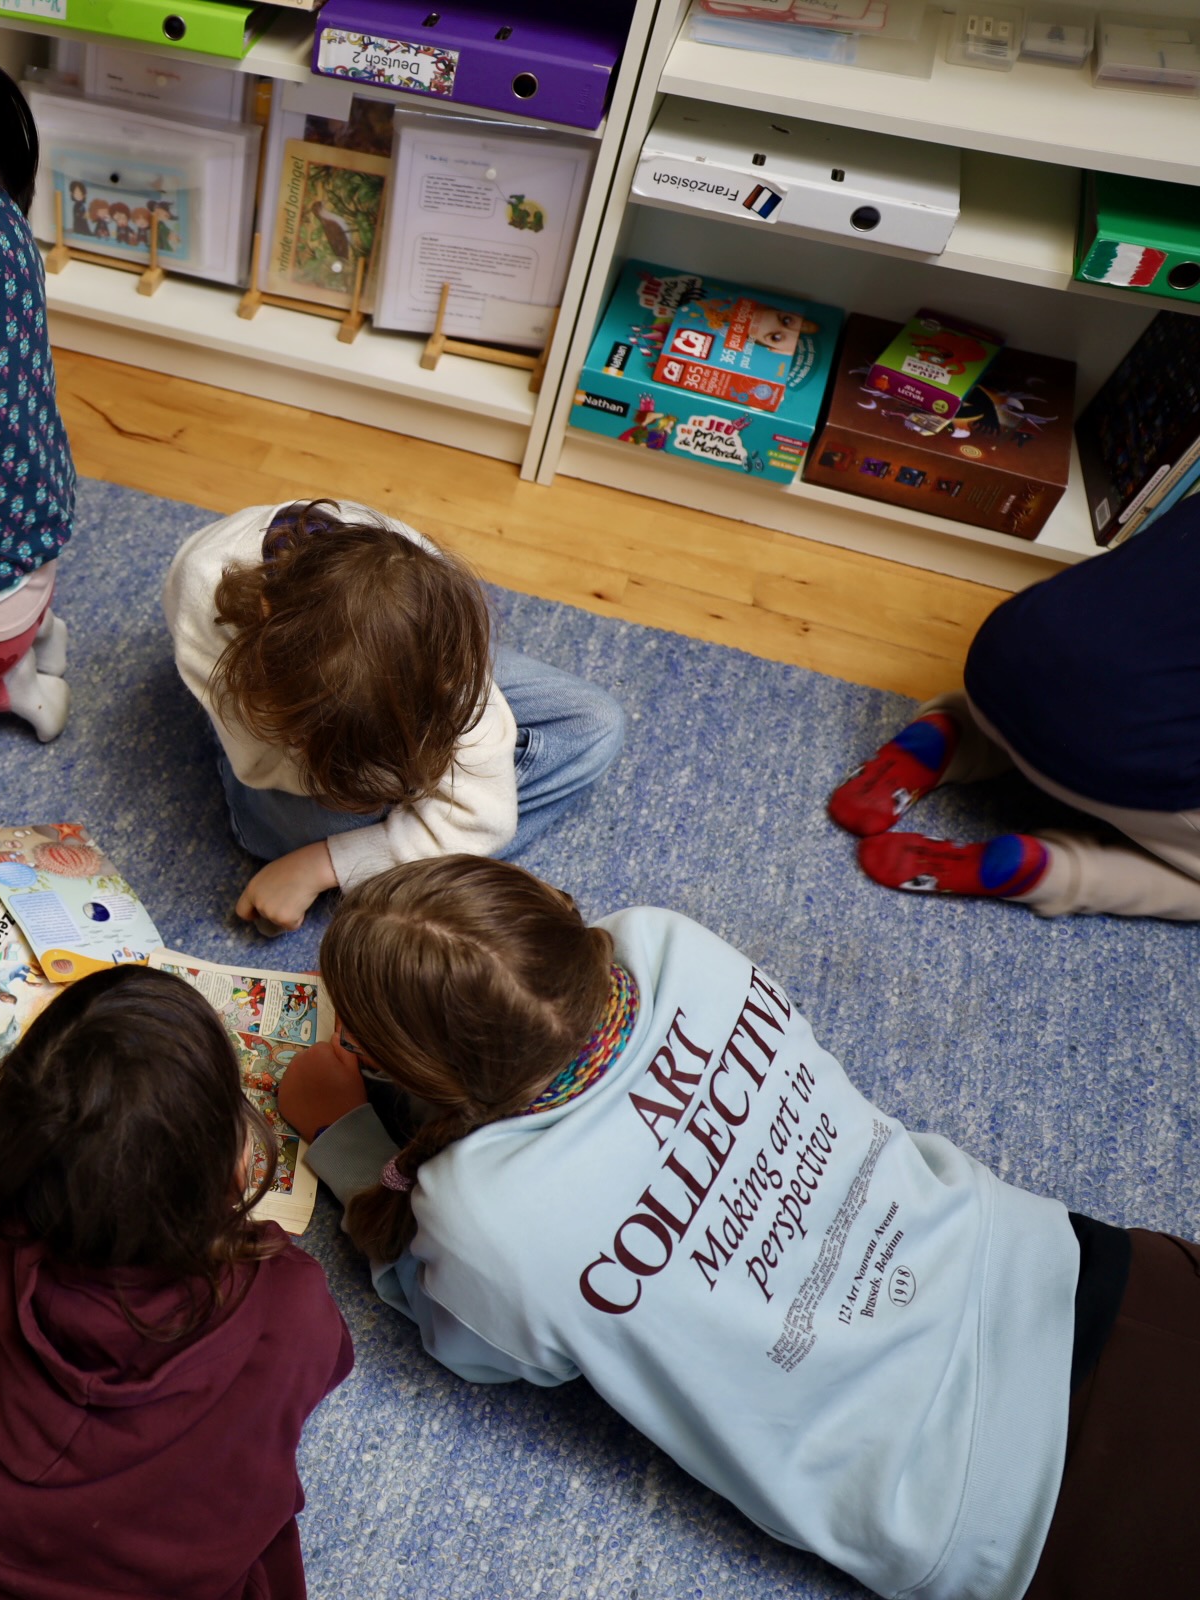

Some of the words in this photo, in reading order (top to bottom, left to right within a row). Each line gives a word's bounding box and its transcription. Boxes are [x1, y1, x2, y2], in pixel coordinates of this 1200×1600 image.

[352, 51, 360, 63] 2
[364, 53, 419, 74] Deutsch
[652, 171, 739, 201] Französisch
[284, 207, 296, 234] und
[733, 323, 744, 333] de
[725, 332, 742, 350] jeux
[719, 347, 737, 364] 365
[683, 364, 704, 388] 365
[907, 362, 944, 376] LECTURE
[919, 371, 938, 379] JEU
[897, 387, 924, 402] LECTURE
[903, 383, 915, 392] JEU
[583, 394, 623, 413] Nathan
[692, 428, 735, 446] prince
[705, 418, 735, 436] JEU
[111, 946, 144, 965] eigel
[628, 1007, 714, 1151] ART
[579, 966, 791, 1316] COLLECTIVE
[689, 1147, 783, 1292] Making
[769, 1095, 800, 1155] art
[788, 1061, 816, 1104] in
[746, 1112, 839, 1304] perspective
[837, 1304, 853, 1324] 123
[846, 1284, 860, 1306] Art
[853, 1238, 877, 1286] Nouveau
[874, 1200, 900, 1239] Avenue
[859, 1276, 883, 1317] Brussels,
[874, 1229, 904, 1273] Belgium
[780, 1336, 808, 1369] expression.
[811, 1300, 819, 1310] we
[817, 1271, 835, 1300] transform
[830, 1260, 840, 1271] the
[849, 1209, 859, 1220] the
[787, 1328, 795, 1338] the
[794, 1300, 804, 1313] Our
[801, 1289, 809, 1300] art
[811, 1272, 820, 1284] our
[828, 1224, 840, 1244] canvas
[893, 1269, 910, 1303] 1998
[771, 1331, 787, 1353] group
[796, 1276, 812, 1296] rebels,
[808, 1261, 819, 1275] and
[814, 1237, 830, 1262] creators.
[774, 1353, 786, 1364] We
[785, 1331, 802, 1353] believe
[802, 1292, 816, 1312] power
